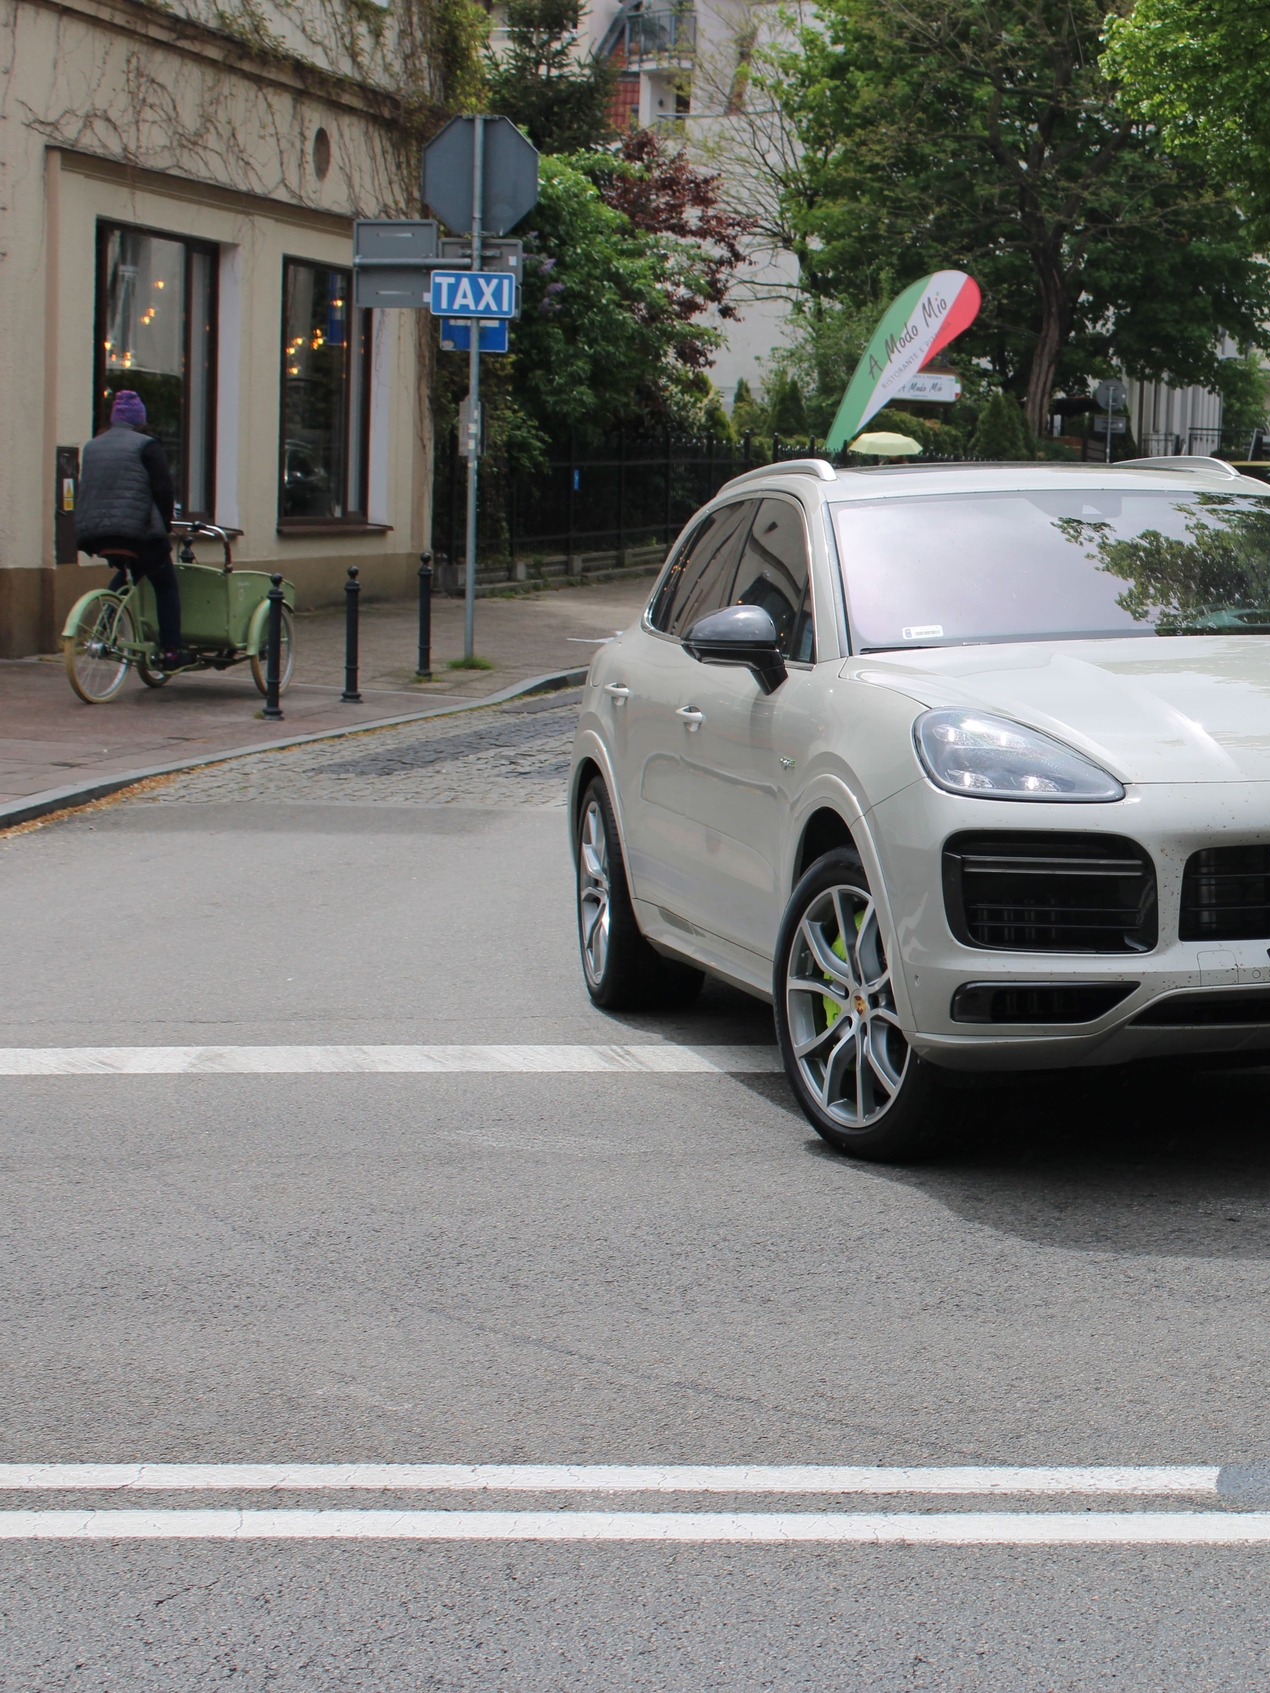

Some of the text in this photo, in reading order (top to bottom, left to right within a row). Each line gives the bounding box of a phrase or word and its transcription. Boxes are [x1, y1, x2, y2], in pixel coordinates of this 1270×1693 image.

[434, 276, 510, 312] TAXI
[868, 291, 947, 380] A Modo Mio
[881, 354, 919, 390] RISTORANTE
